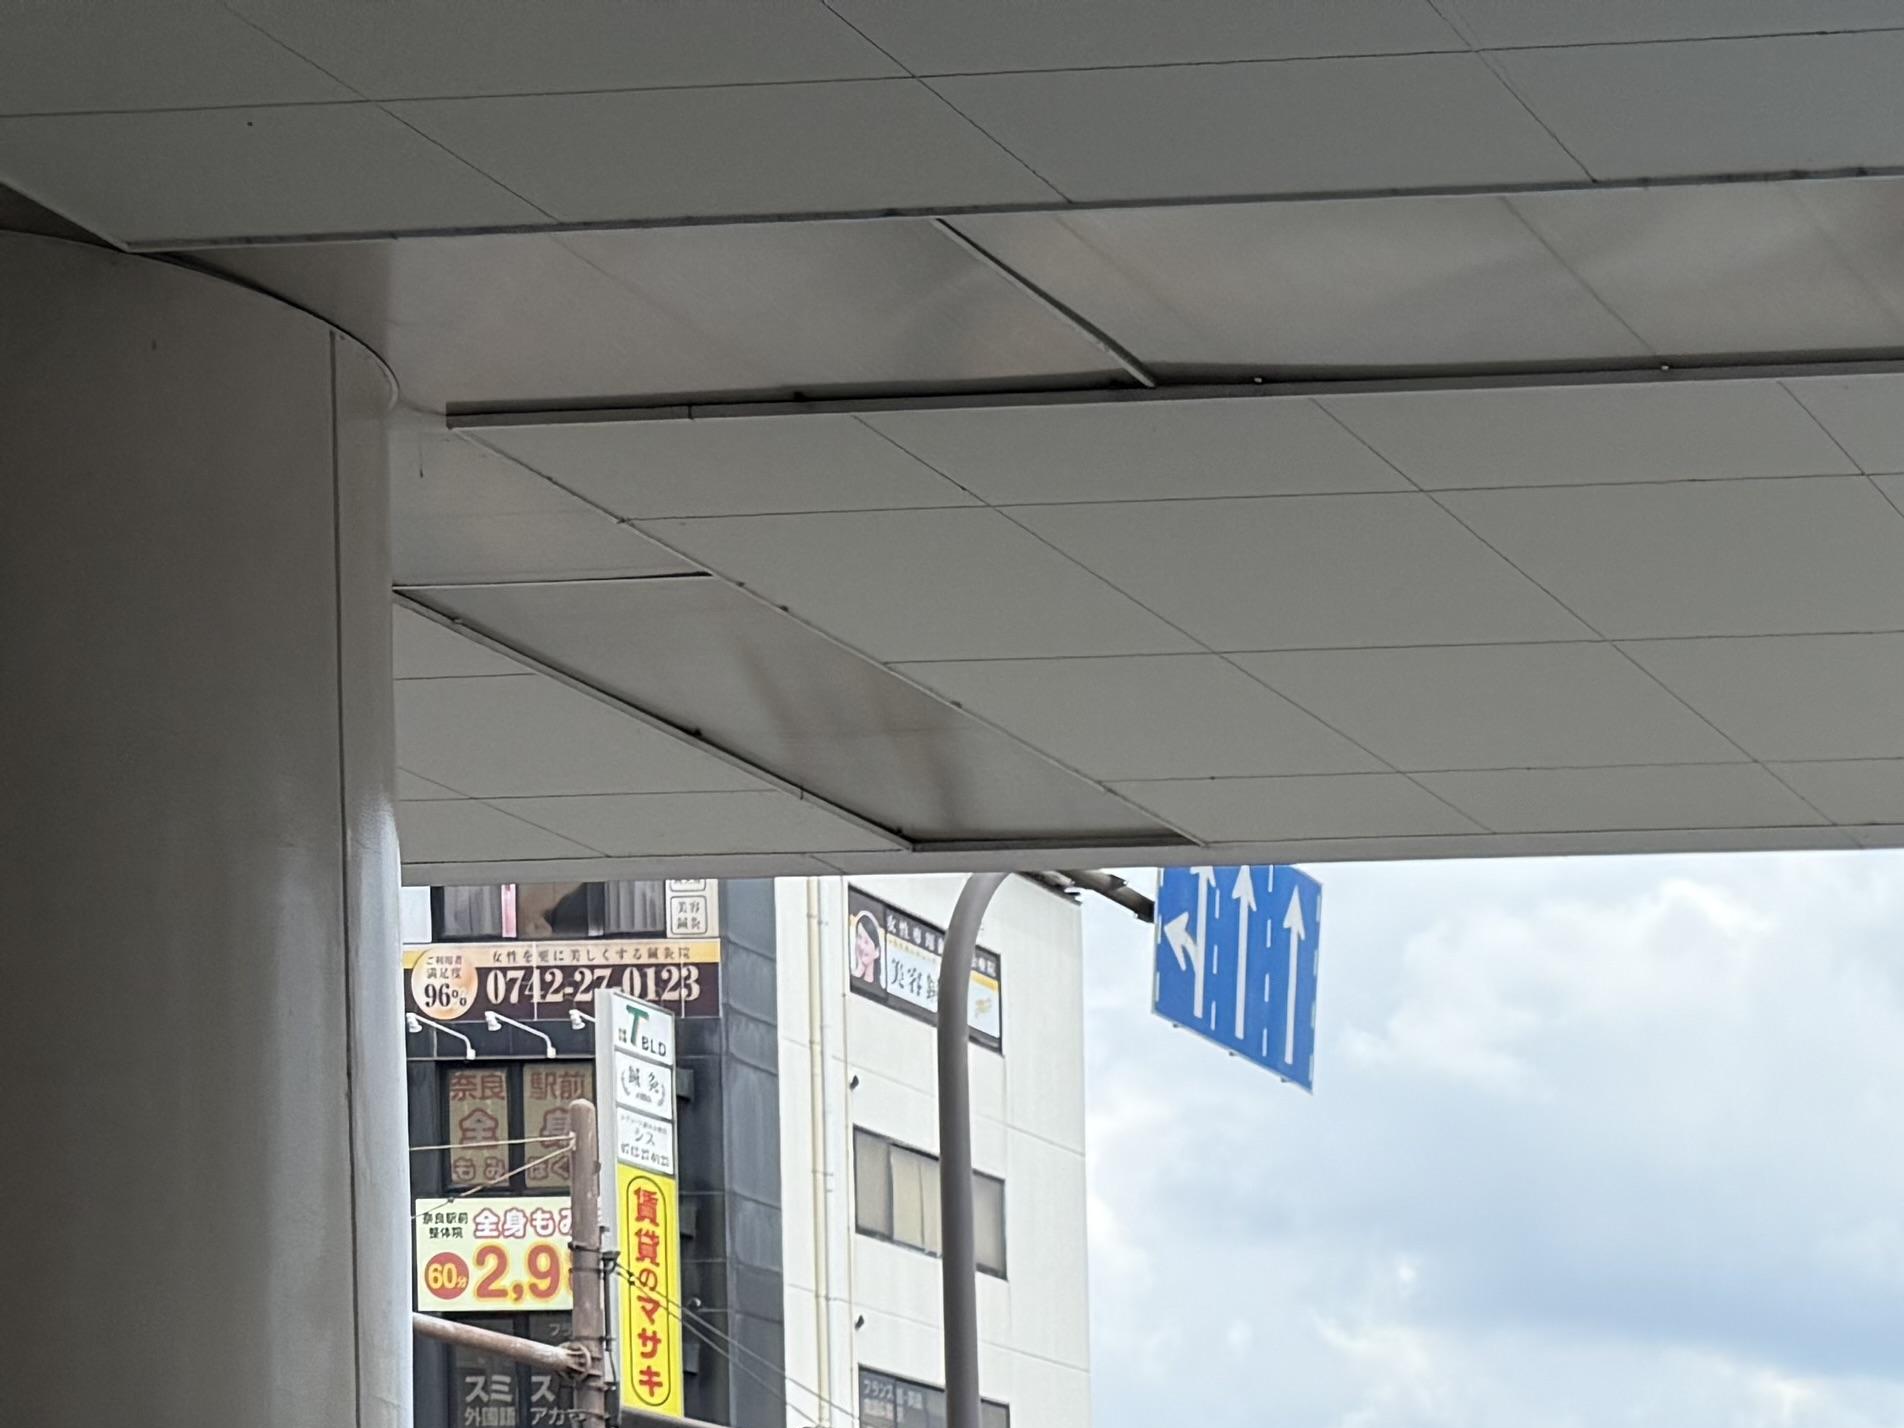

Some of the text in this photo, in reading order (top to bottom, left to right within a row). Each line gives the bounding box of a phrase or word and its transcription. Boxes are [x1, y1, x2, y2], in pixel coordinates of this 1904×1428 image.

[424, 984, 468, 1007] 96%
[486, 966, 700, 1005] 0742-27-0123
[641, 1035, 667, 1057] BLD
[427, 1262, 467, 1289] 60分
[475, 1244, 572, 1301] 2,9
[633, 1186, 663, 1398] 賃貸のマサキ
